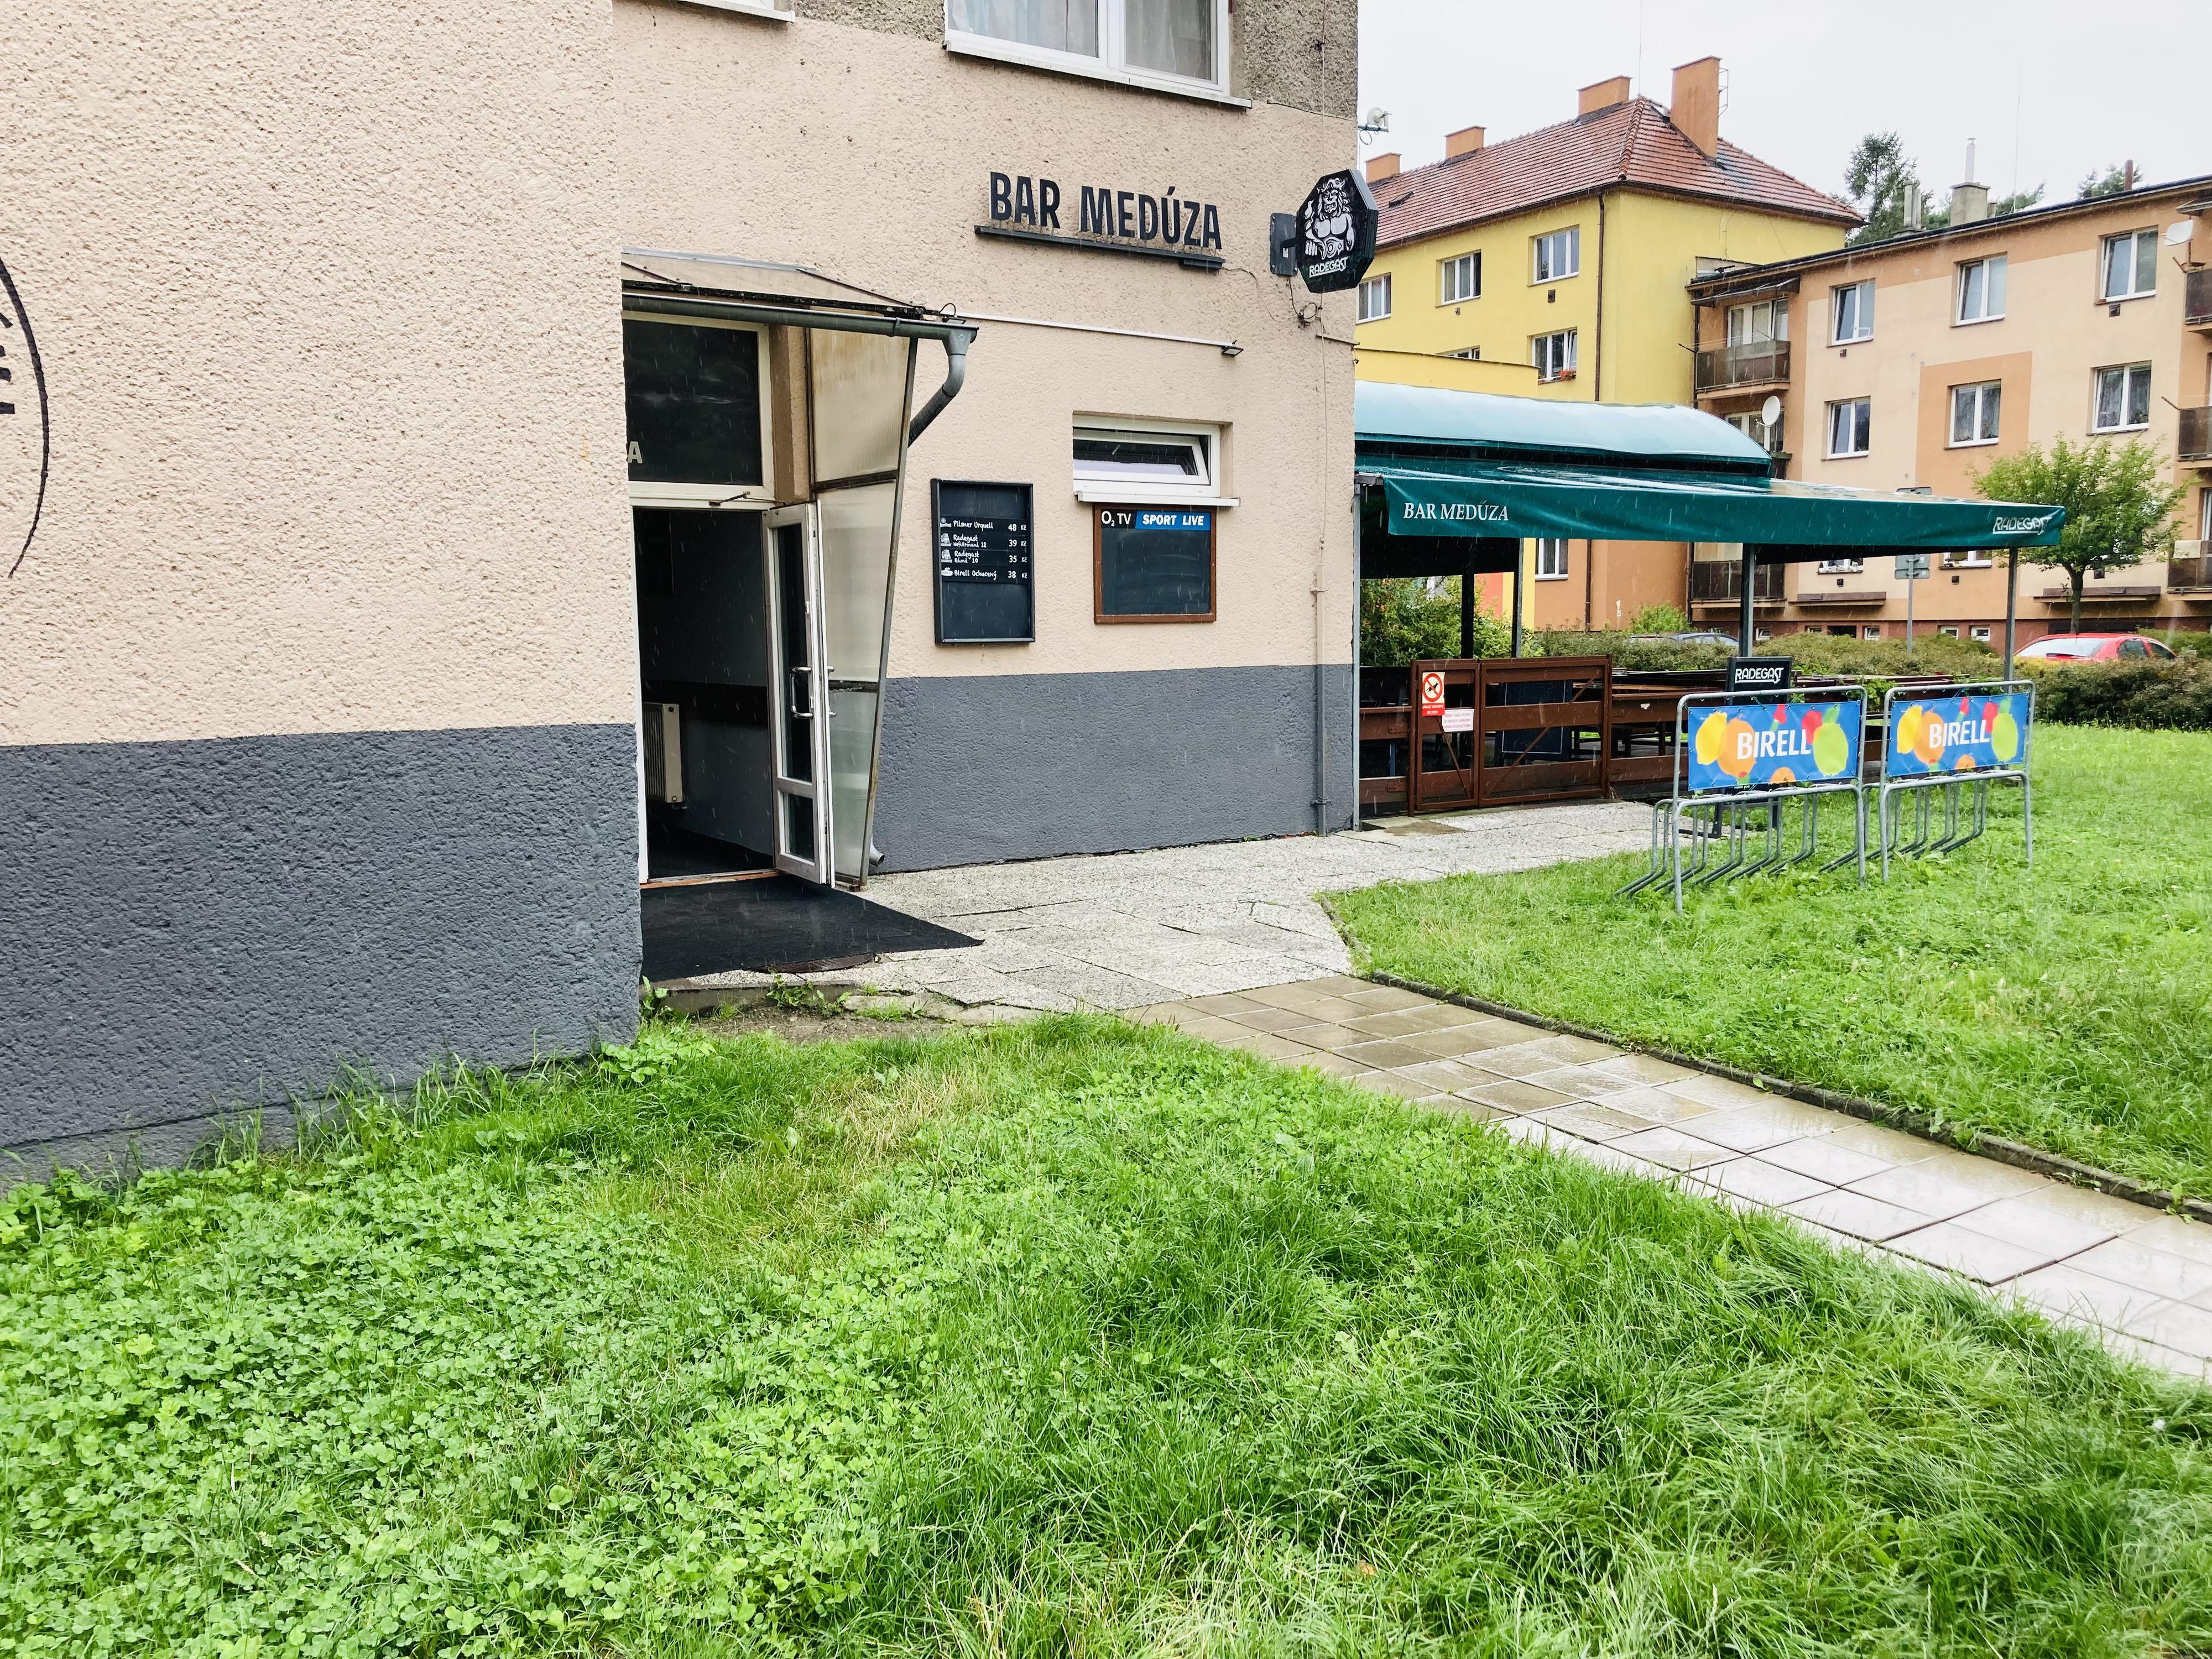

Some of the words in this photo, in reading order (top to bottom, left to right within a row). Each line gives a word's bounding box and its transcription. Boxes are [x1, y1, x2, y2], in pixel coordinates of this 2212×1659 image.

[988, 171, 1061, 229] BAR
[1078, 185, 1222, 250] MEDÚZA
[1309, 256, 1349, 278] RADEGAST
[1403, 502, 1437, 520] BAR
[1440, 500, 1509, 521] MEDÚZA
[953, 520, 972, 528] Pilsner
[974, 521, 993, 531] Urquell
[1008, 523, 1016, 531] 48
[1117, 513, 1132, 525] TV
[1142, 514, 1177, 526] SPORT
[1182, 515, 1204, 526] LIVE
[953, 533, 978, 543] Radegast
[1008, 539, 1017, 547] 39
[954, 550, 979, 559] Radegast
[1009, 555, 1017, 563] 35
[972, 570, 997, 581] Ochucený
[1008, 570, 1016, 578] 38
[1734, 666, 1785, 685] RADEGAST
[1929, 719, 1991, 749] BIRELL
[1736, 728, 1813, 760] BIRELL
